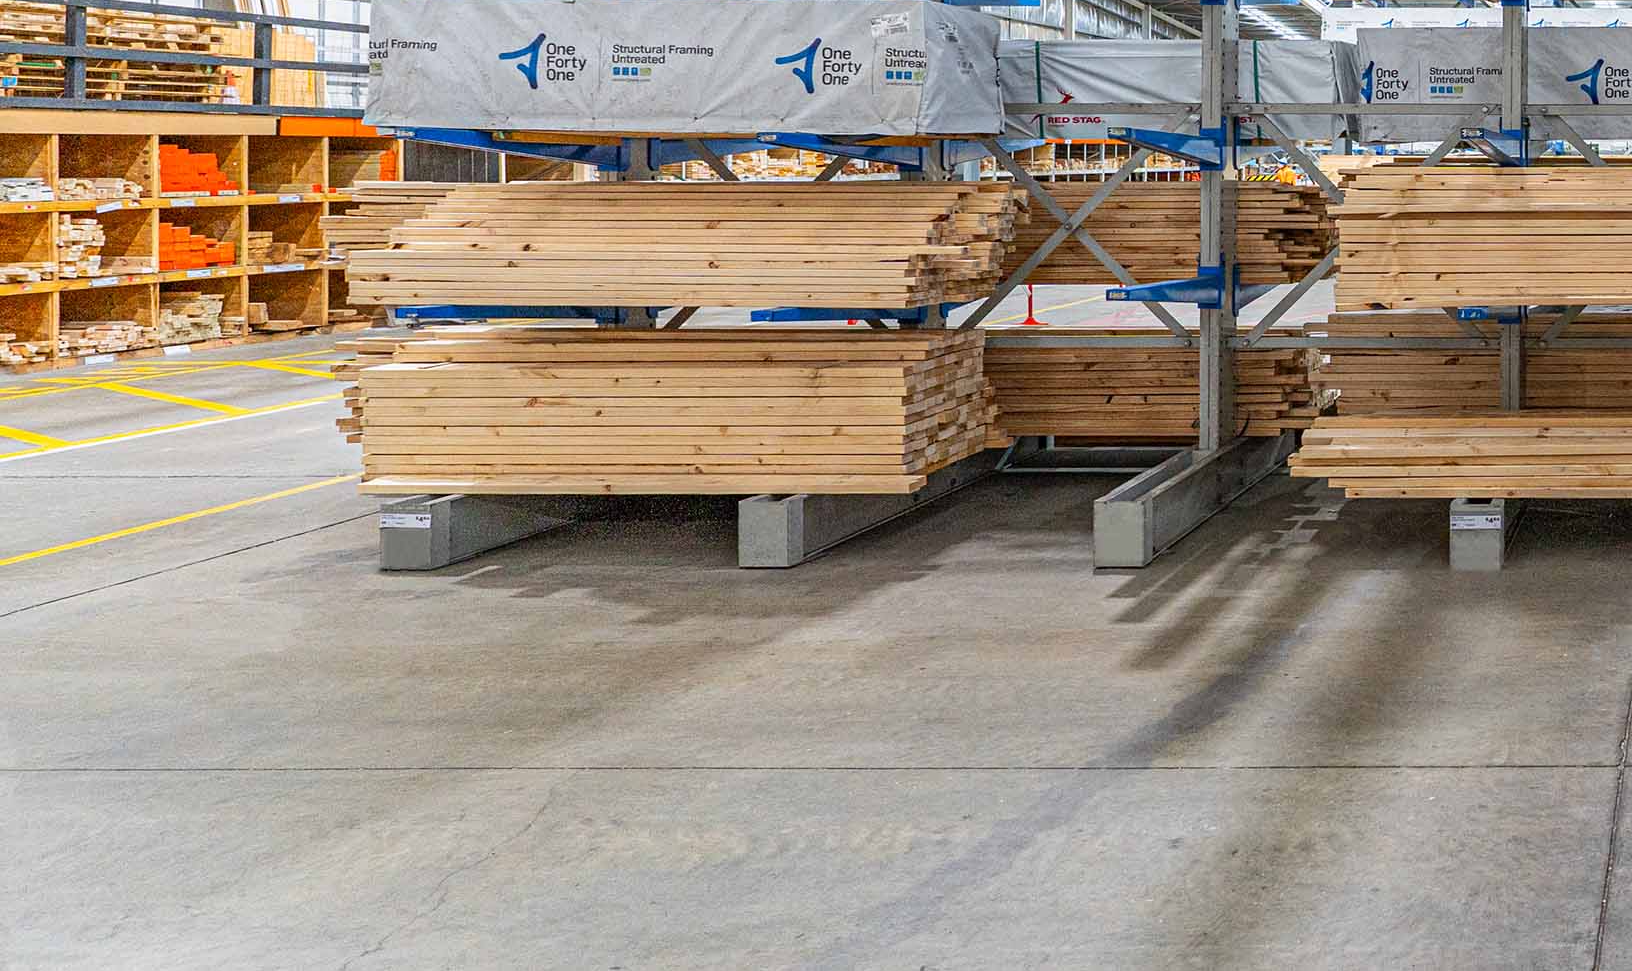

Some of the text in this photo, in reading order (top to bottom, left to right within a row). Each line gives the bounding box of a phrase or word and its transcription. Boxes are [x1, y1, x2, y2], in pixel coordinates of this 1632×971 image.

[546, 43, 575, 55] One
[613, 44, 713, 57] Structural Framing
[822, 47, 851, 60] One
[547, 56, 587, 71] Forty
[612, 55, 665, 64] Untreated
[823, 60, 862, 75] Forty
[1376, 68, 1398, 78] One
[1430, 67, 1474, 75] Structural
[1605, 67, 1629, 77] One
[547, 69, 574, 81] One
[822, 73, 849, 85] One
[1376, 79, 1408, 91] Forty
[1376, 89, 1398, 100] One
[1605, 88, 1629, 98] One
